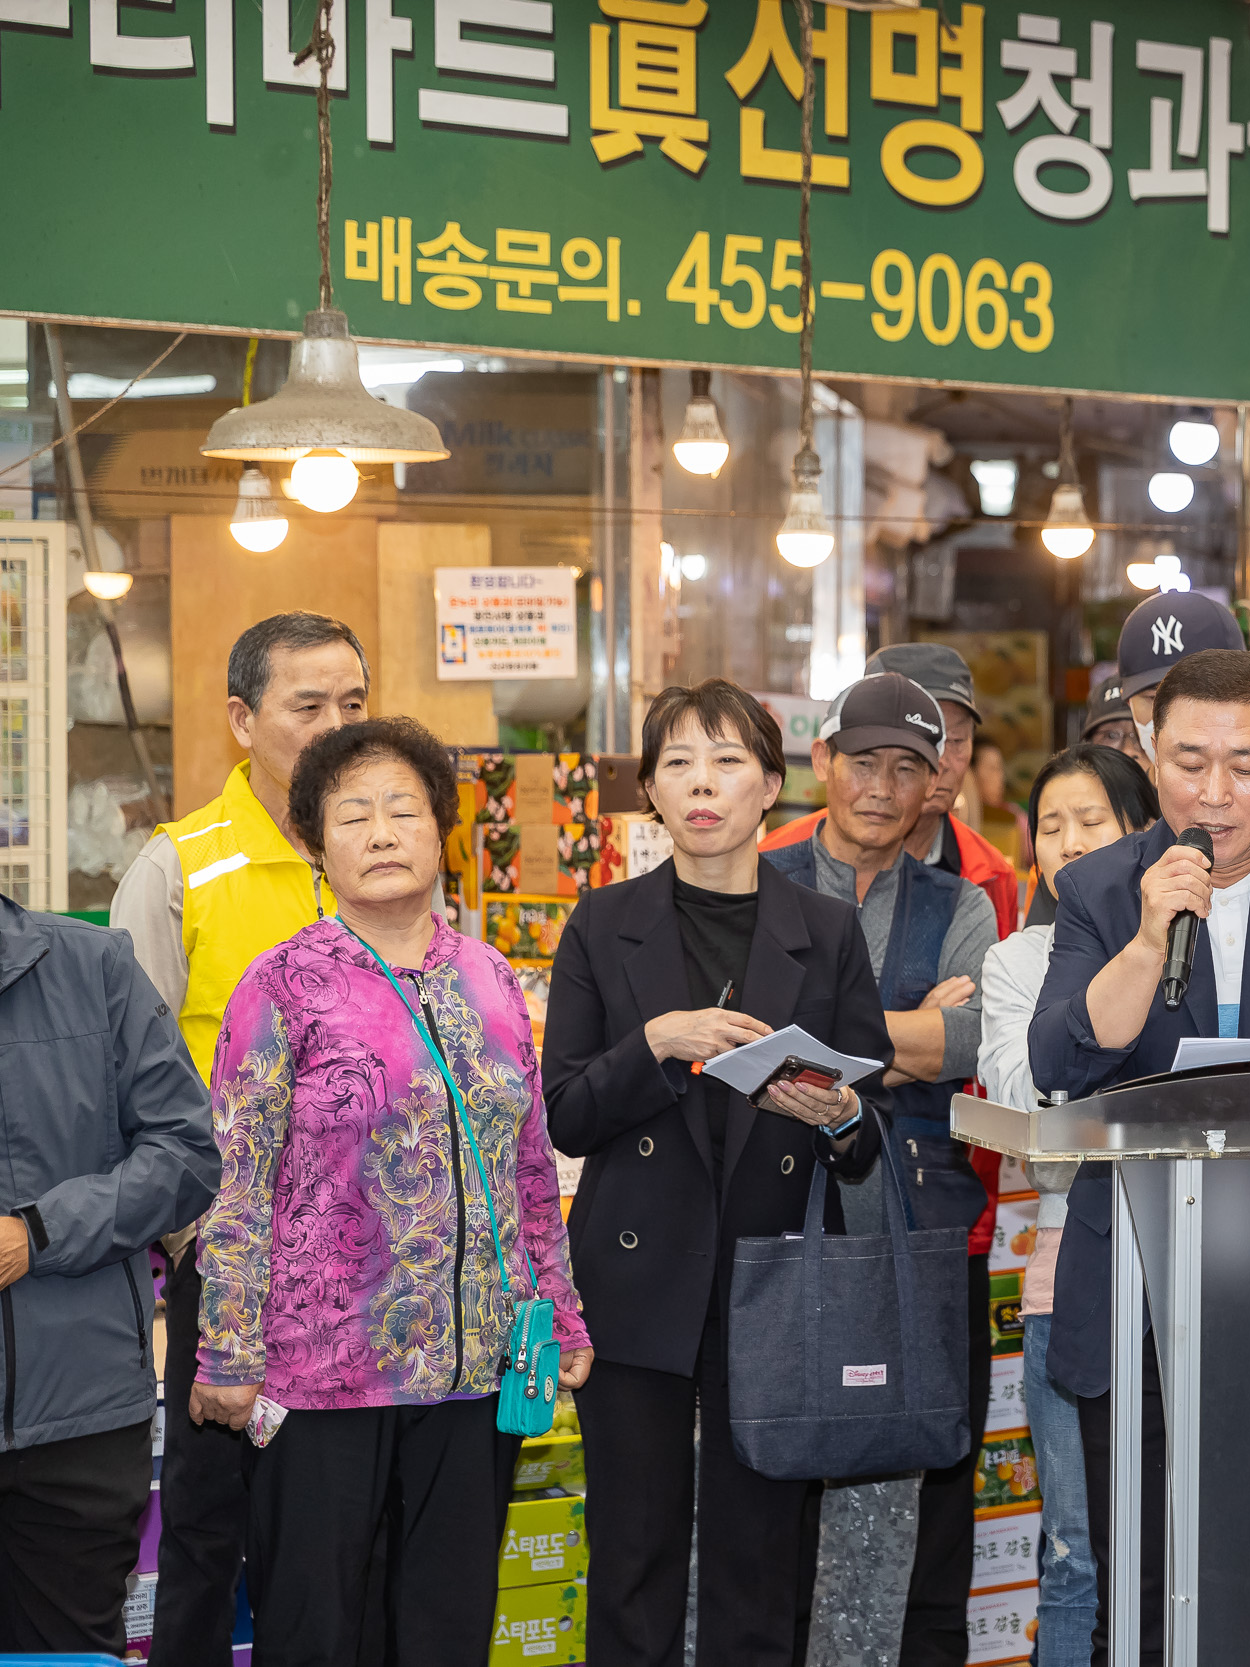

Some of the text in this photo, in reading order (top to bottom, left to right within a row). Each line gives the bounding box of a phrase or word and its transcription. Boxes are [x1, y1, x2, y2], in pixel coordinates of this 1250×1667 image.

[345, 216, 1054, 353] 배송문의. 455-9063
[503, 1528, 564, 1560] 스타포도
[494, 1613, 556, 1645] 스타포도
